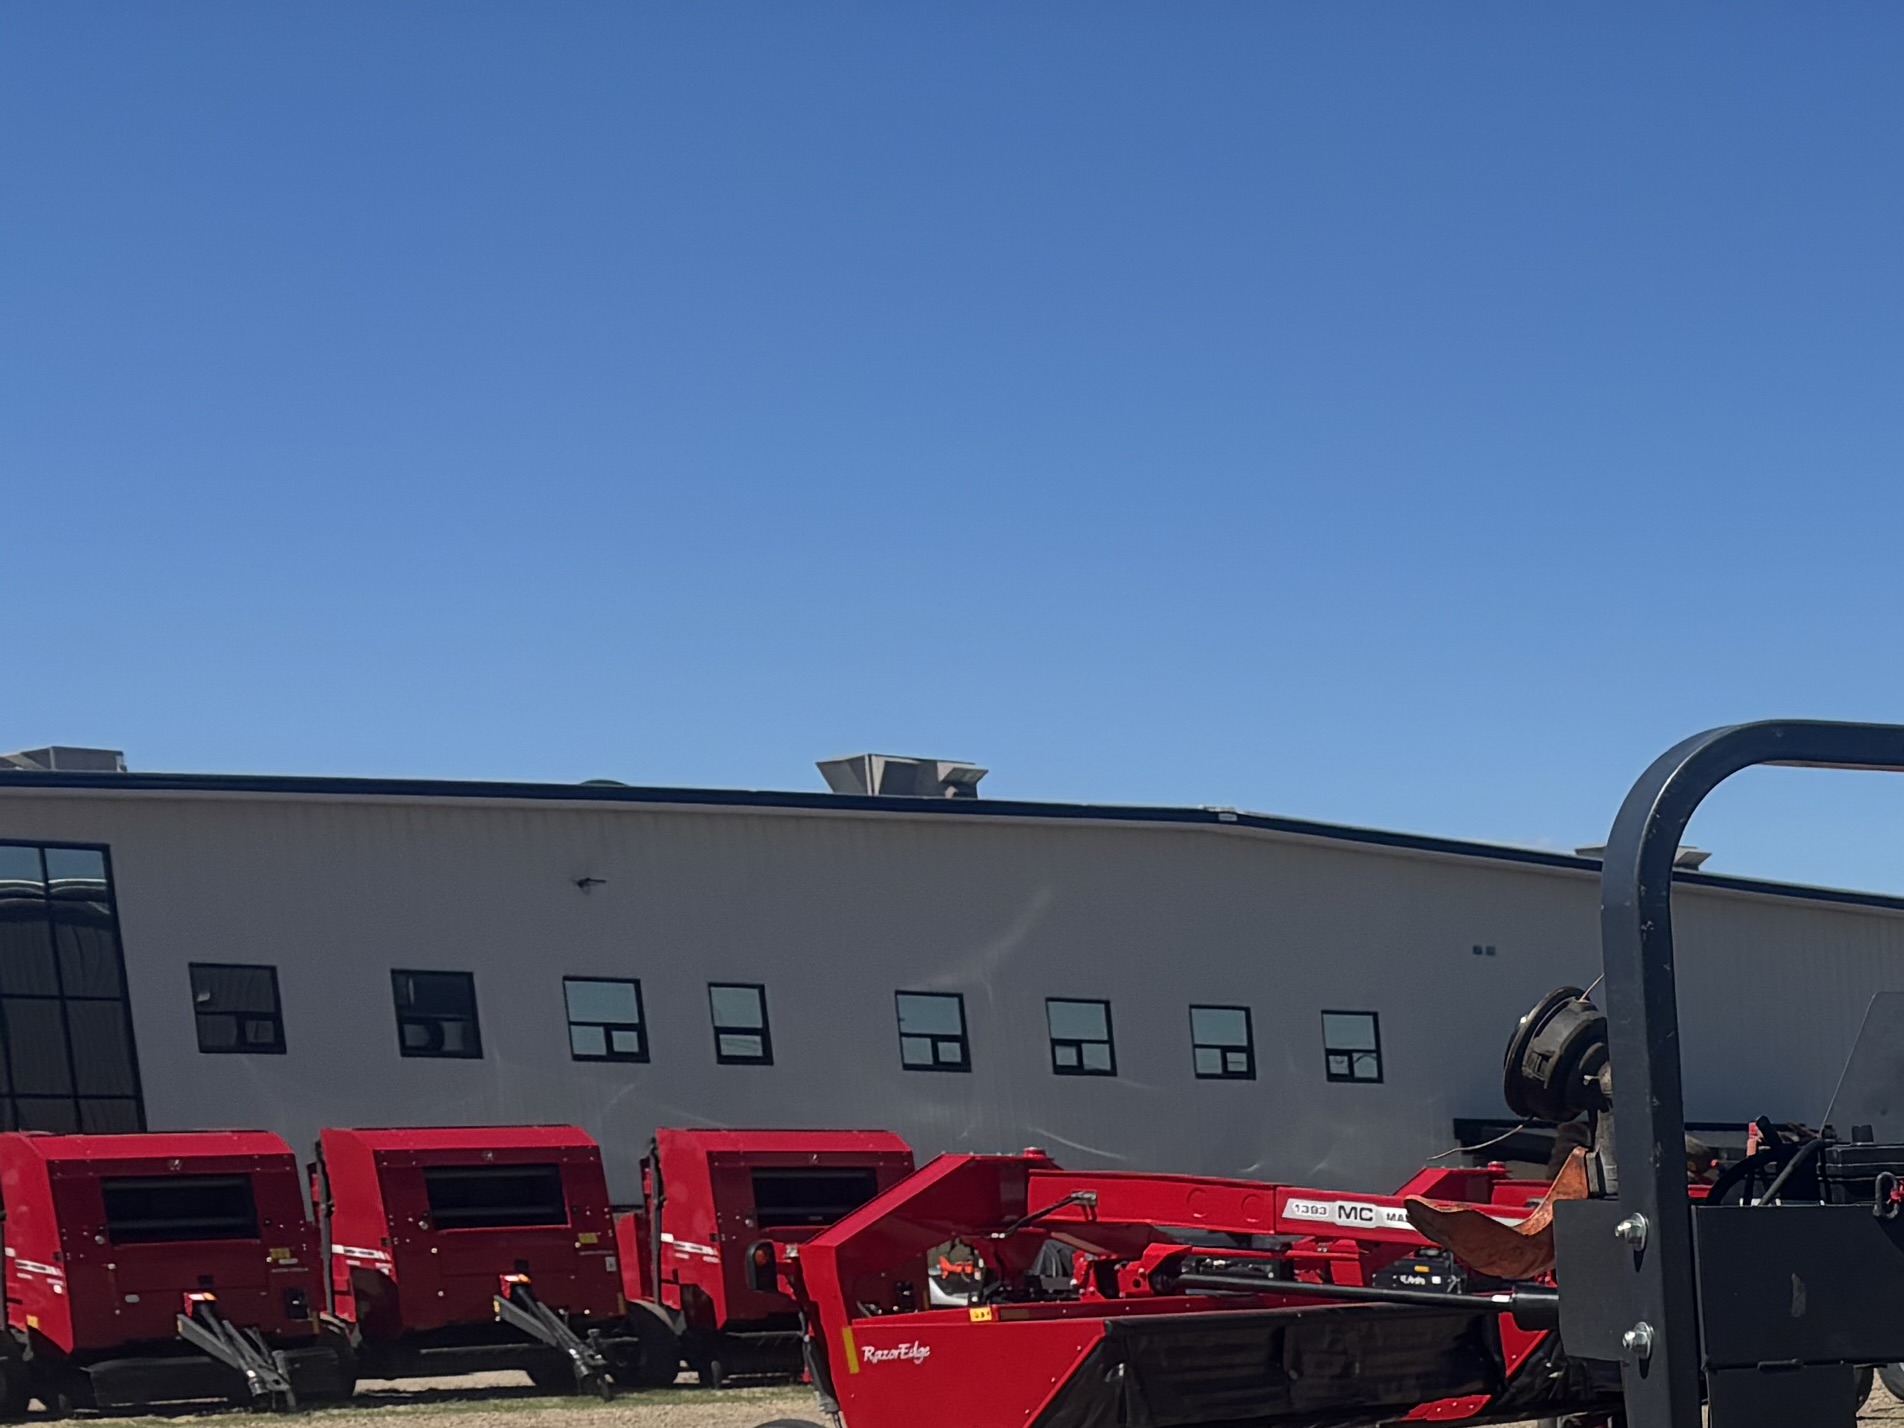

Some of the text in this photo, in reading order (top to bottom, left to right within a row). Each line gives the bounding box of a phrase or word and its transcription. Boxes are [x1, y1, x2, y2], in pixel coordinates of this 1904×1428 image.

[1294, 1203, 1328, 1215] 1393
[1337, 1205, 1374, 1222] MC
[861, 1341, 931, 1365] RazorEdge
